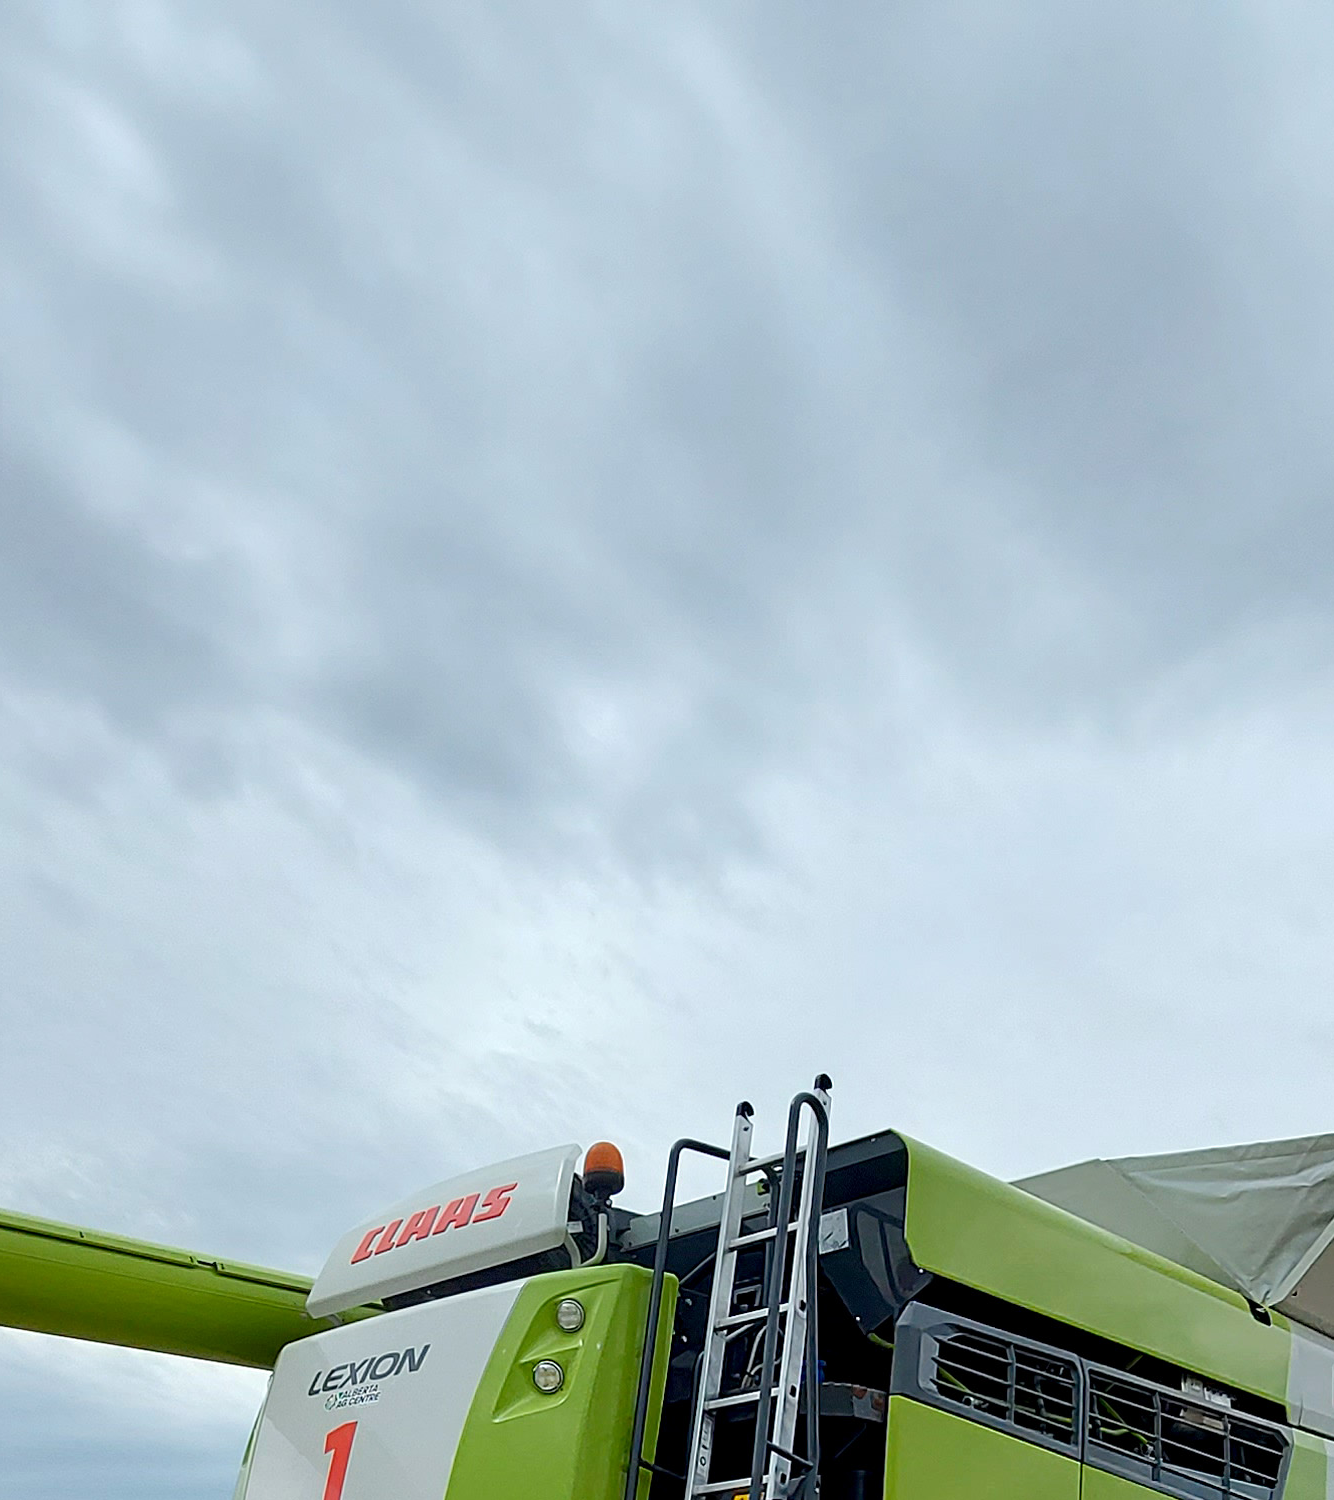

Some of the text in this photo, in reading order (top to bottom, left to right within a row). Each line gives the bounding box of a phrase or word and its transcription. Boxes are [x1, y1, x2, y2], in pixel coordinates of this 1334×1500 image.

[351, 1182, 518, 1264] CLAAS
[308, 1344, 431, 1397] LEXION
[336, 1392, 381, 1409] AG CENTRE
[341, 1384, 379, 1399] ALBERTA
